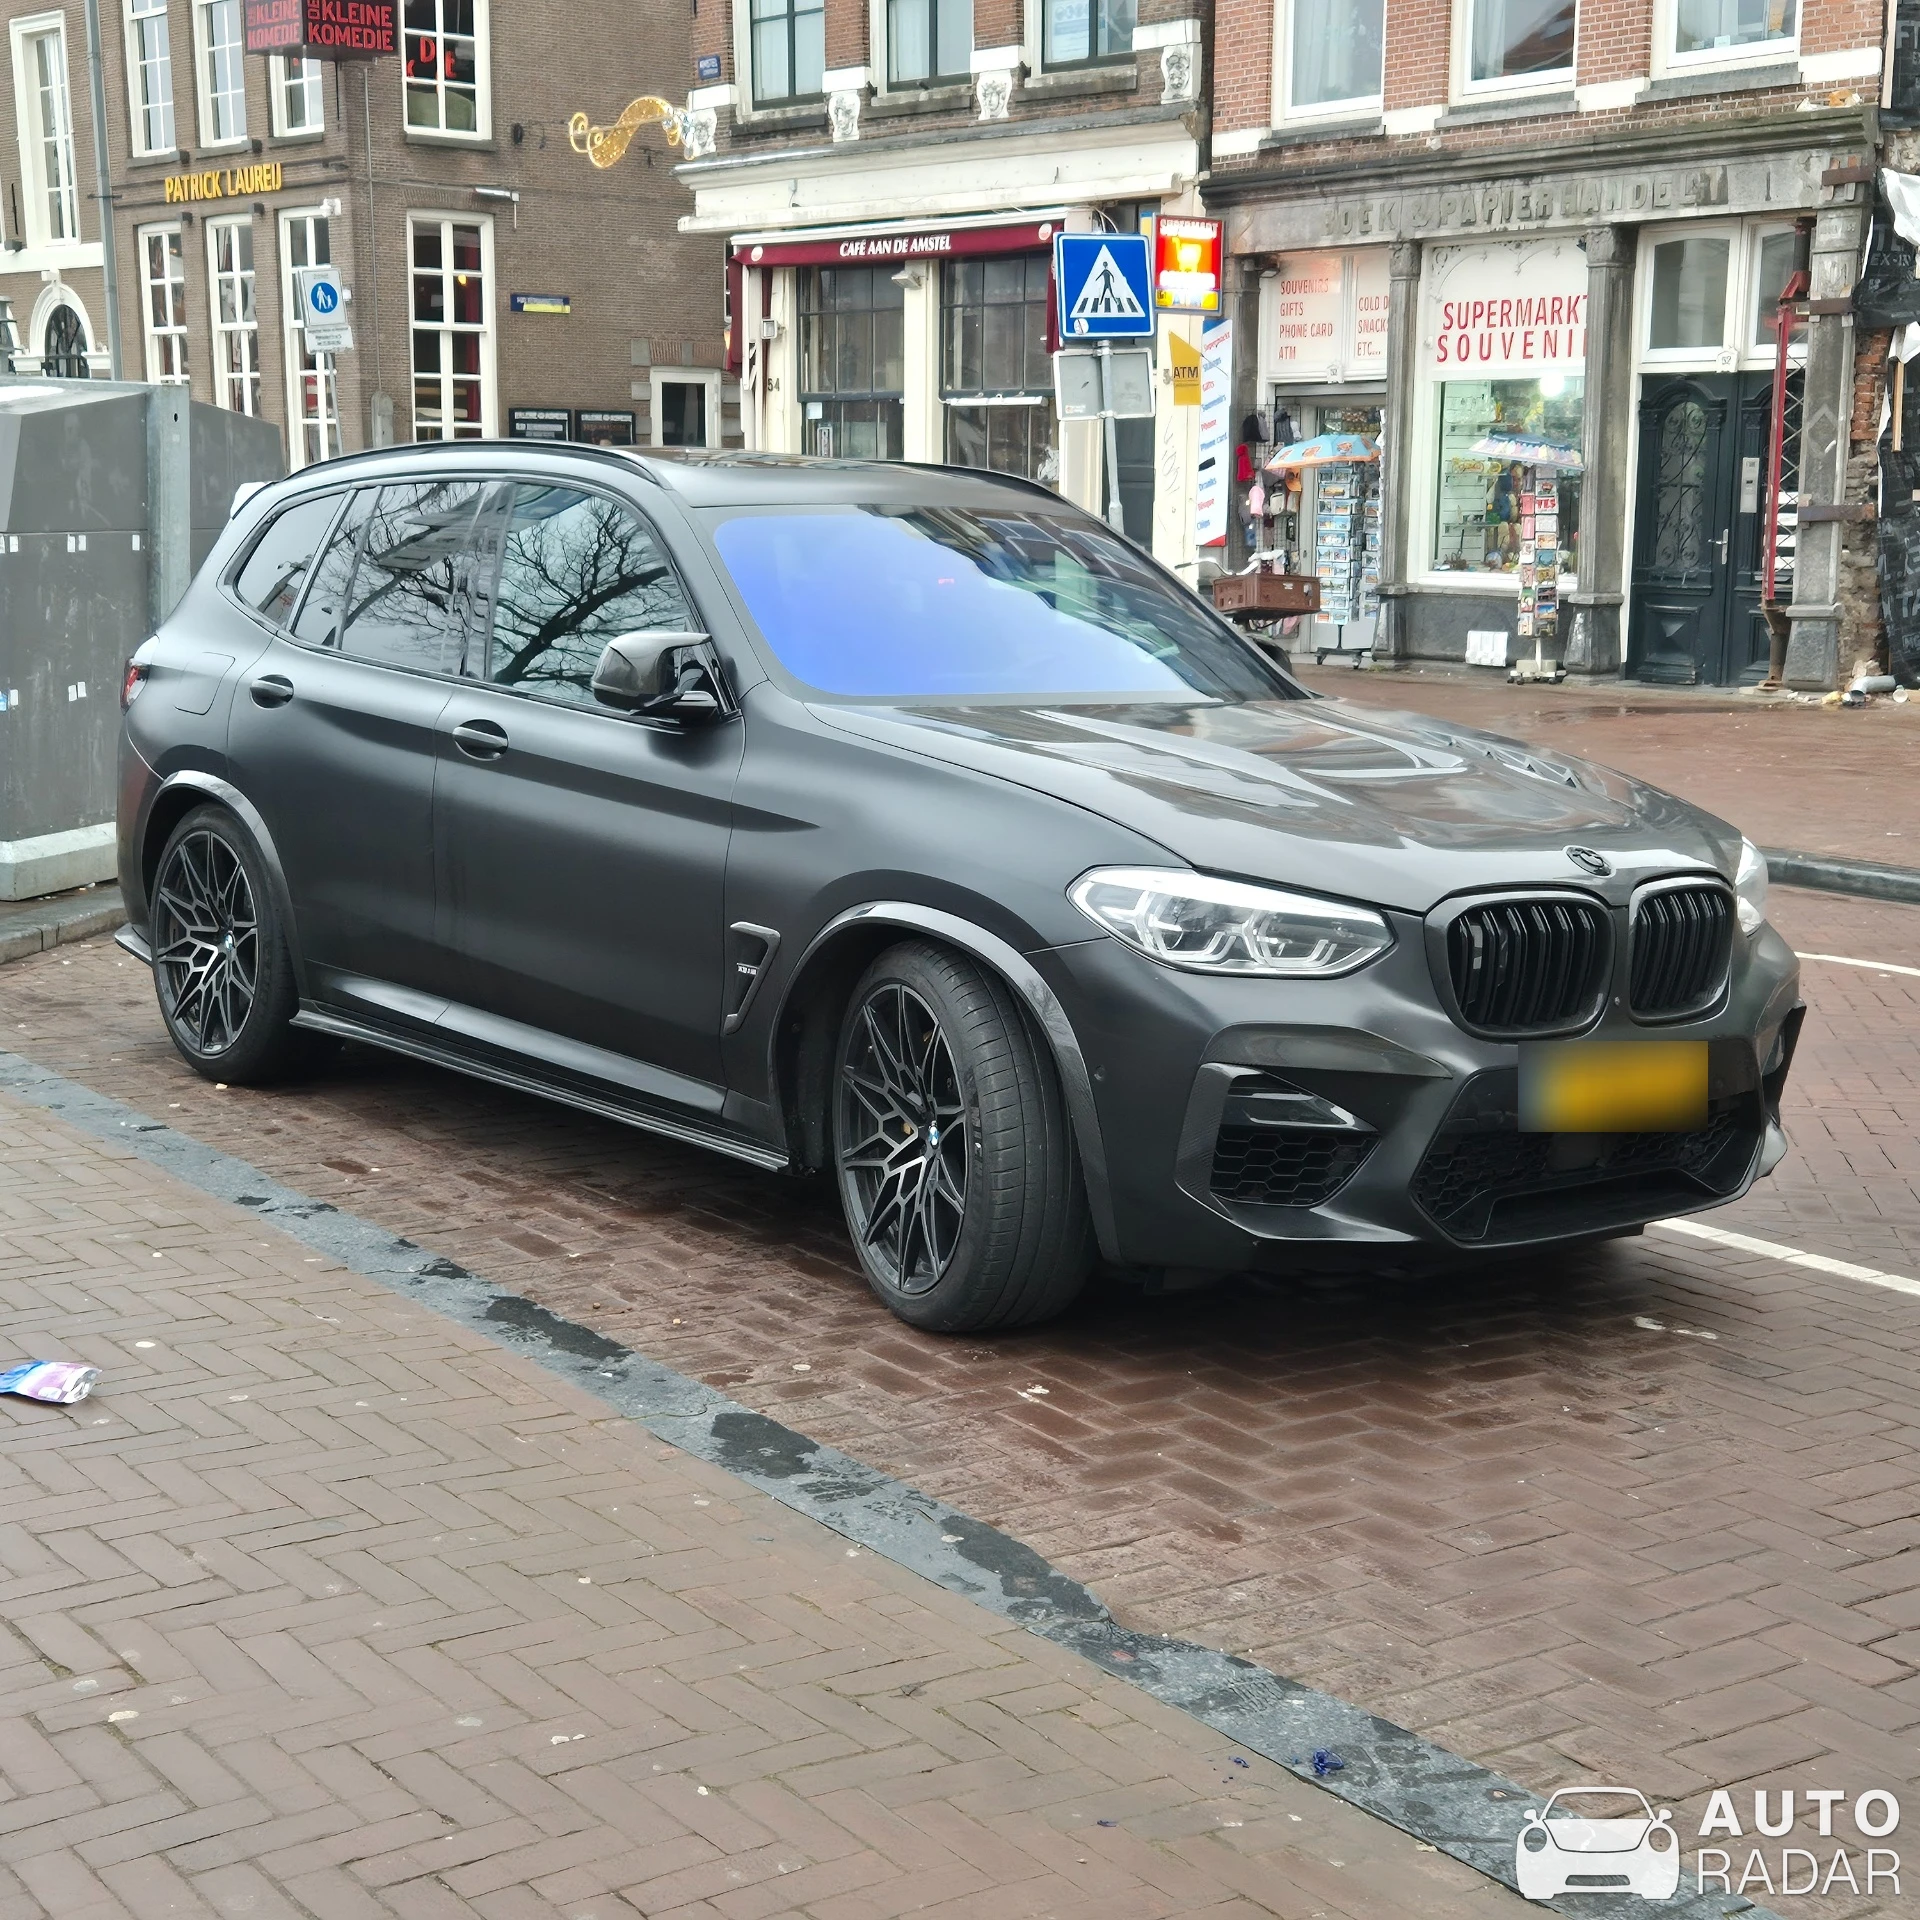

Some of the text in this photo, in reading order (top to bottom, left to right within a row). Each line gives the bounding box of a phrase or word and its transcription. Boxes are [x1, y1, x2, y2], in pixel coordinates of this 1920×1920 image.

[256, 0, 300, 25] KLEINE
[322, 0, 393, 28] KLEINE
[247, 22, 300, 51] KOMEDIE
[307, 22, 394, 51] KOMEDIE
[165, 170, 222, 203] PATRICK
[839, 234, 952, 257] CAFÉ AAN DE AMSTEL
[1280, 278, 1330, 295] SOUVENIRS
[1280, 301, 1304, 317] GIFTS
[1358, 296, 1380, 312] COLD
[1442, 294, 1588, 331] SUPERMARK
[1279, 322, 1333, 339] PHONE CARD
[1357, 318, 1389, 335] SNACK
[1278, 345, 1296, 360] ATM
[1173, 366, 1199, 379] ATM
[767, 377, 780, 392] 54
